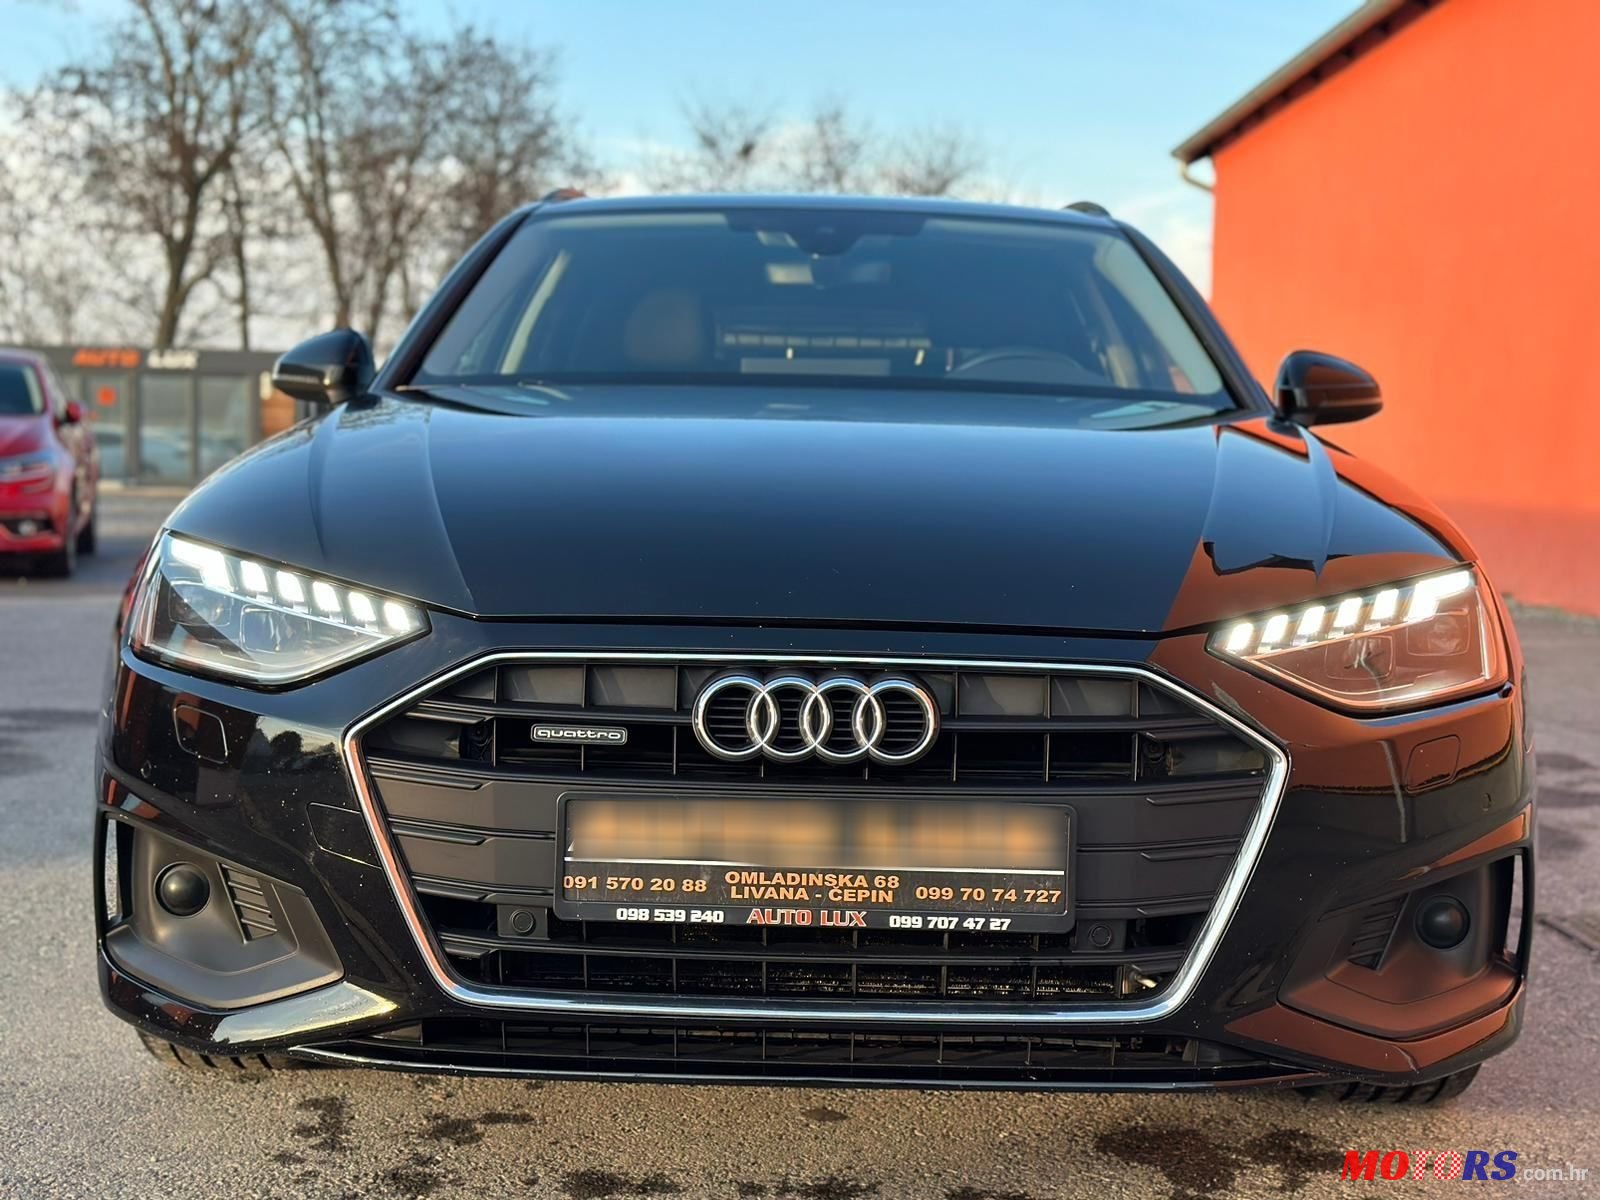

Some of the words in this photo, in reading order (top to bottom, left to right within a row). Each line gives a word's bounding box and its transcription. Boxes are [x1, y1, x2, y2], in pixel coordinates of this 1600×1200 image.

[537, 729, 621, 739] quattro
[563, 876, 597, 889] 091
[606, 877, 643, 890] 570
[650, 879, 675, 891] 20
[681, 879, 707, 892] 88
[724, 871, 868, 888] OMLADINSKA
[873, 875, 900, 889] 68
[730, 886, 809, 900] LIVANA
[828, 886, 893, 903] ČEPIN
[915, 886, 953, 900] 099
[960, 888, 985, 901] 70
[992, 889, 1017, 902] 74
[1024, 890, 1061, 903] 727
[616, 908, 649, 921] 098
[654, 909, 686, 922] 539
[690, 910, 724, 923] 240
[746, 908, 812, 925] AUTO
[820, 910, 867, 927] LUX
[889, 914, 922, 929] 099
[927, 916, 958, 929] 707
[962, 917, 985, 930] 47
[989, 918, 1012, 931] 27
